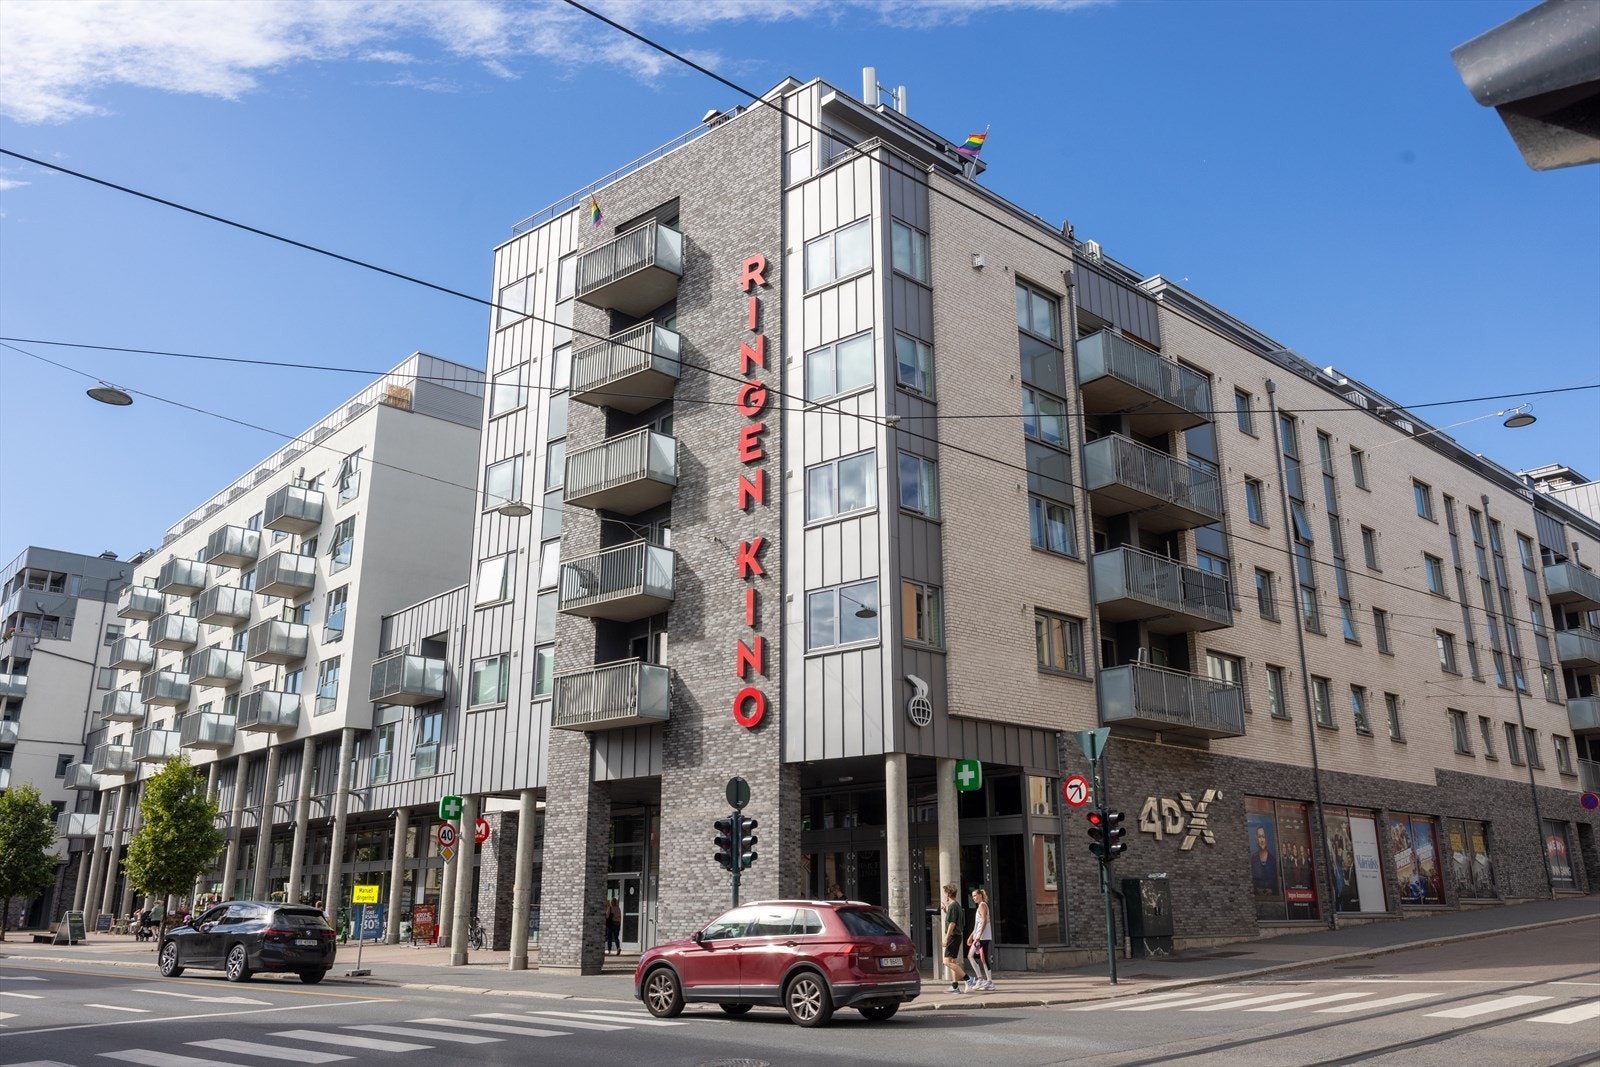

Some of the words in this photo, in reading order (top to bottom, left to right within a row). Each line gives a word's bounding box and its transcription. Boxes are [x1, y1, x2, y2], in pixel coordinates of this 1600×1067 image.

[740, 256, 768, 511] RINGEN
[734, 539, 766, 731] KINO
[441, 830, 453, 841] 40
[1138, 788, 1217, 851] 4DX
